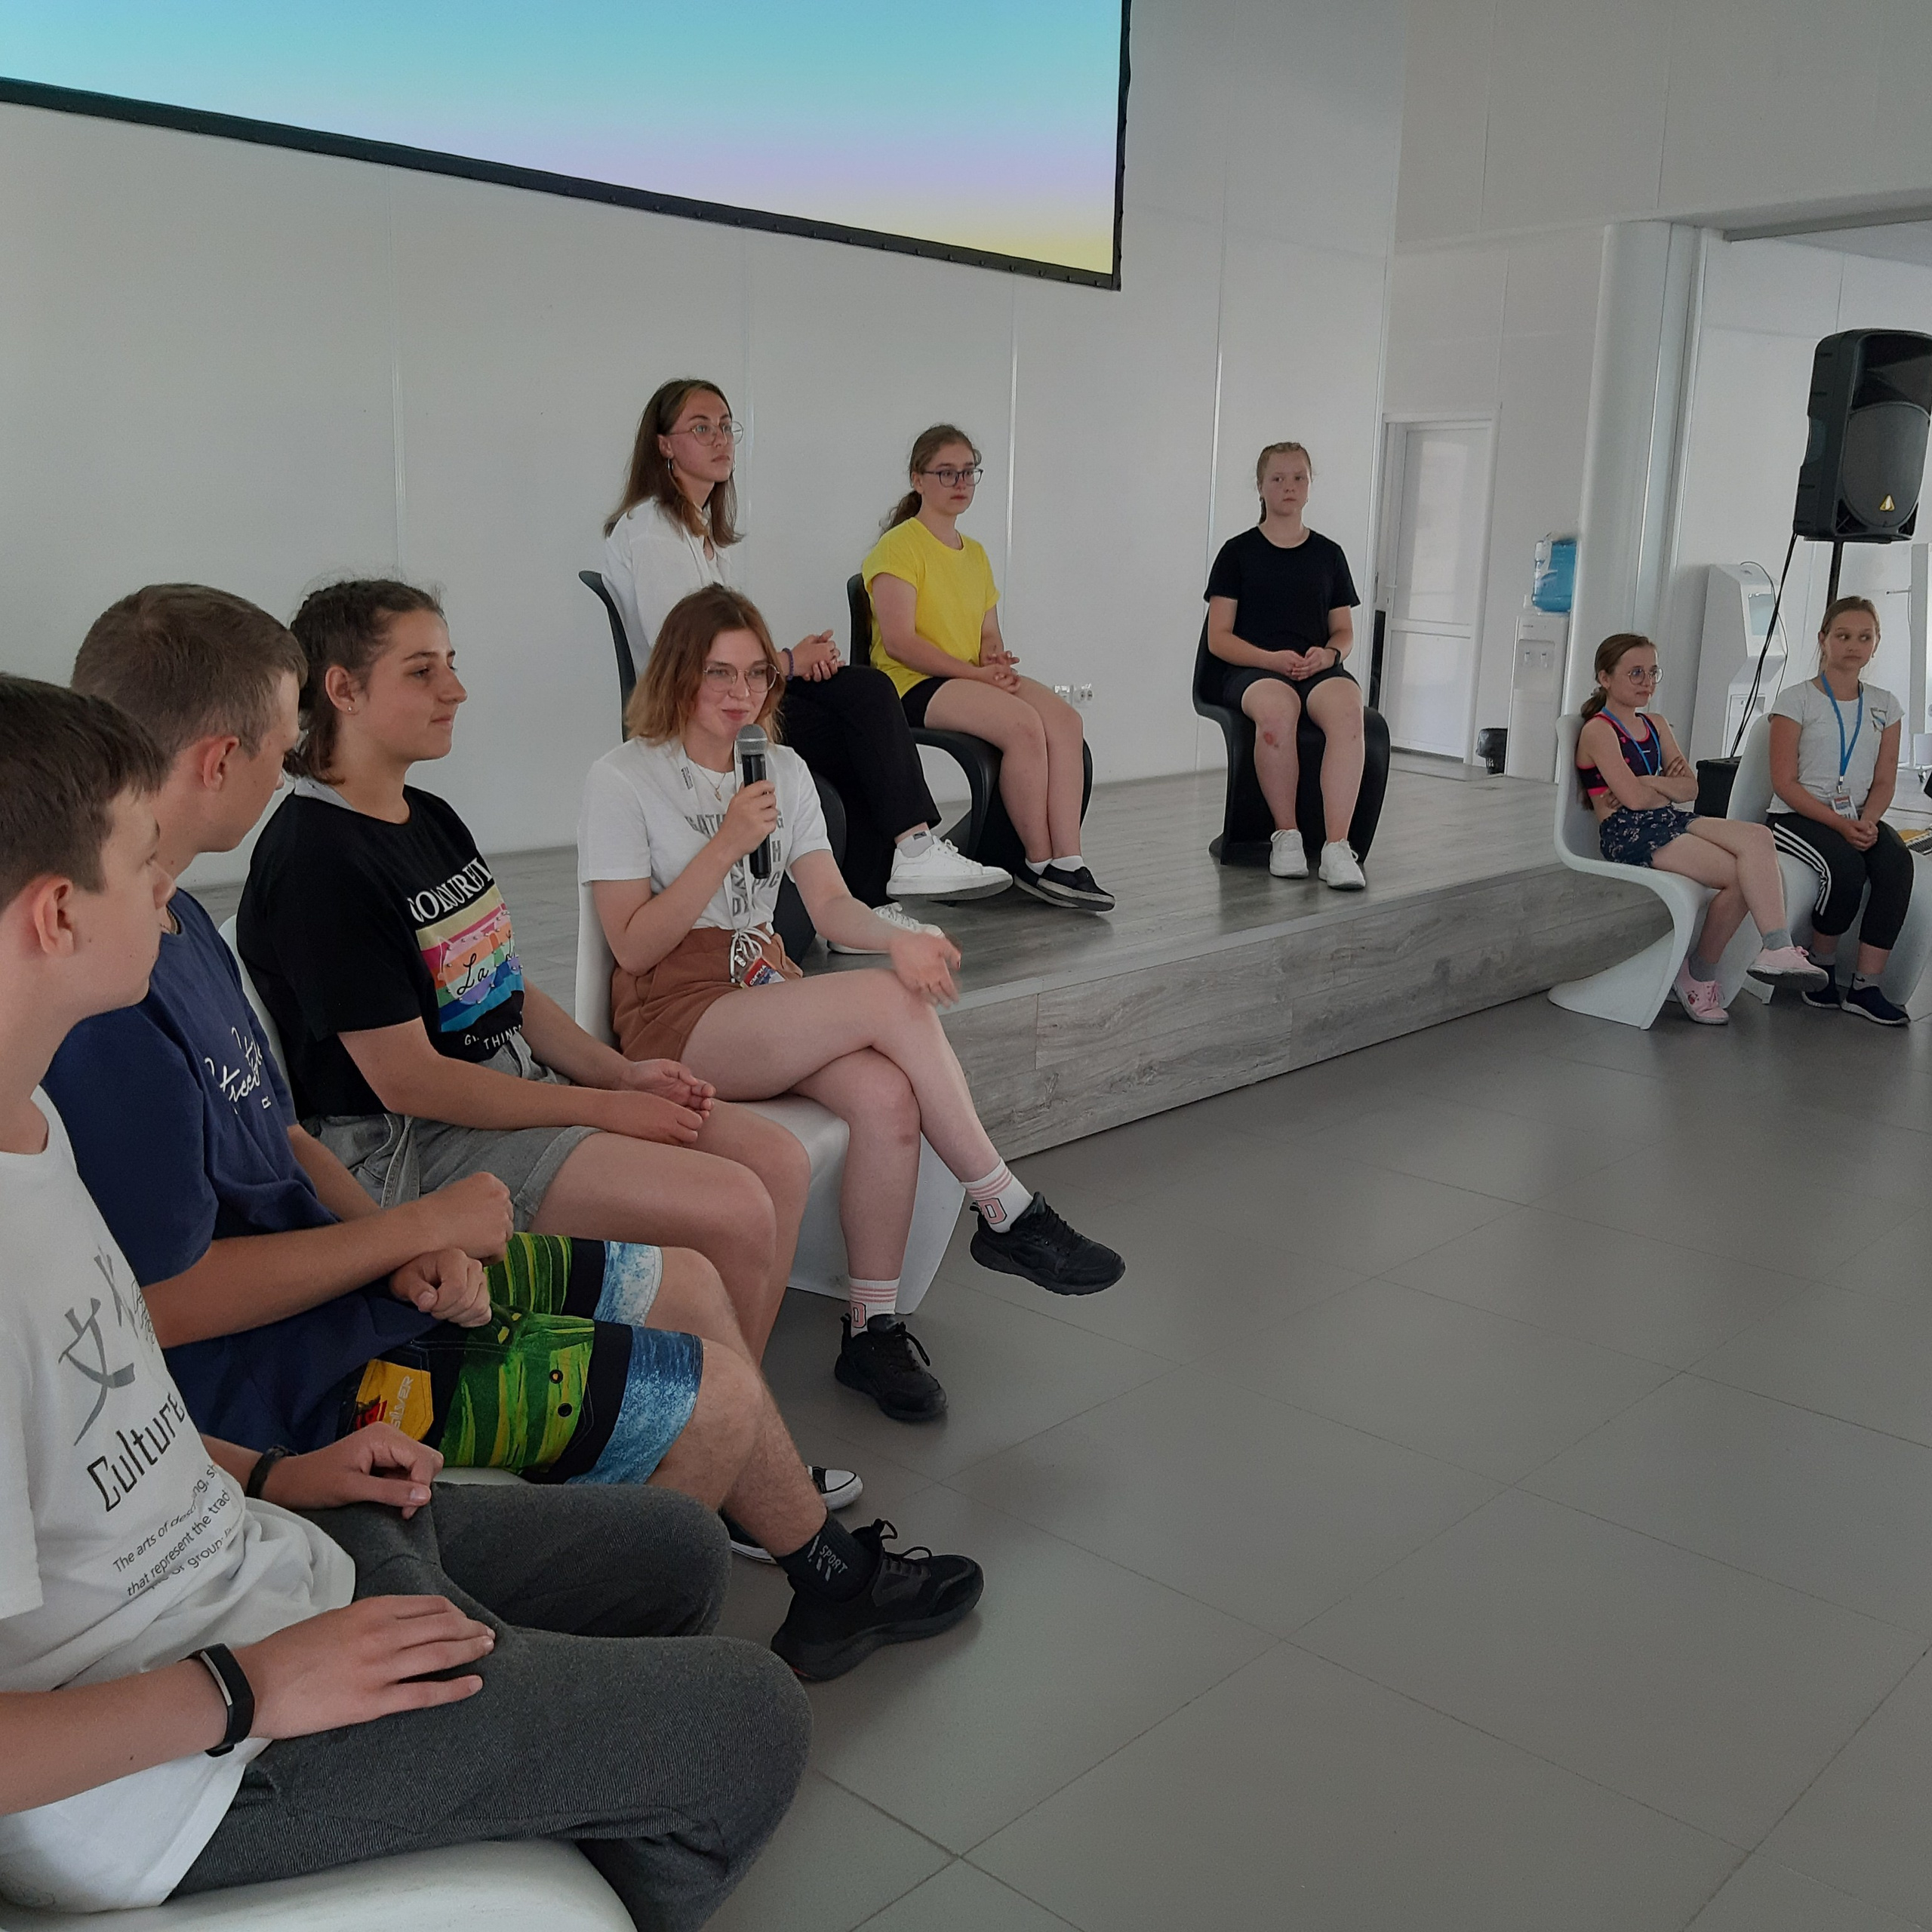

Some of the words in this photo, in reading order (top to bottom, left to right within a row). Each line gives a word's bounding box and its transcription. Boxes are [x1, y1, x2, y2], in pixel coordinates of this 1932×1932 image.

[457, 953, 489, 995] La
[88, 1392, 186, 1512] Culture
[113, 1551, 135, 1572] The
[137, 1534, 157, 1555] arts
[158, 1520, 169, 1538] of
[127, 1573, 151, 1596] that
[150, 1532, 195, 1578] represent
[192, 1515, 211, 1535] the
[820, 1544, 848, 1574] SPORT
